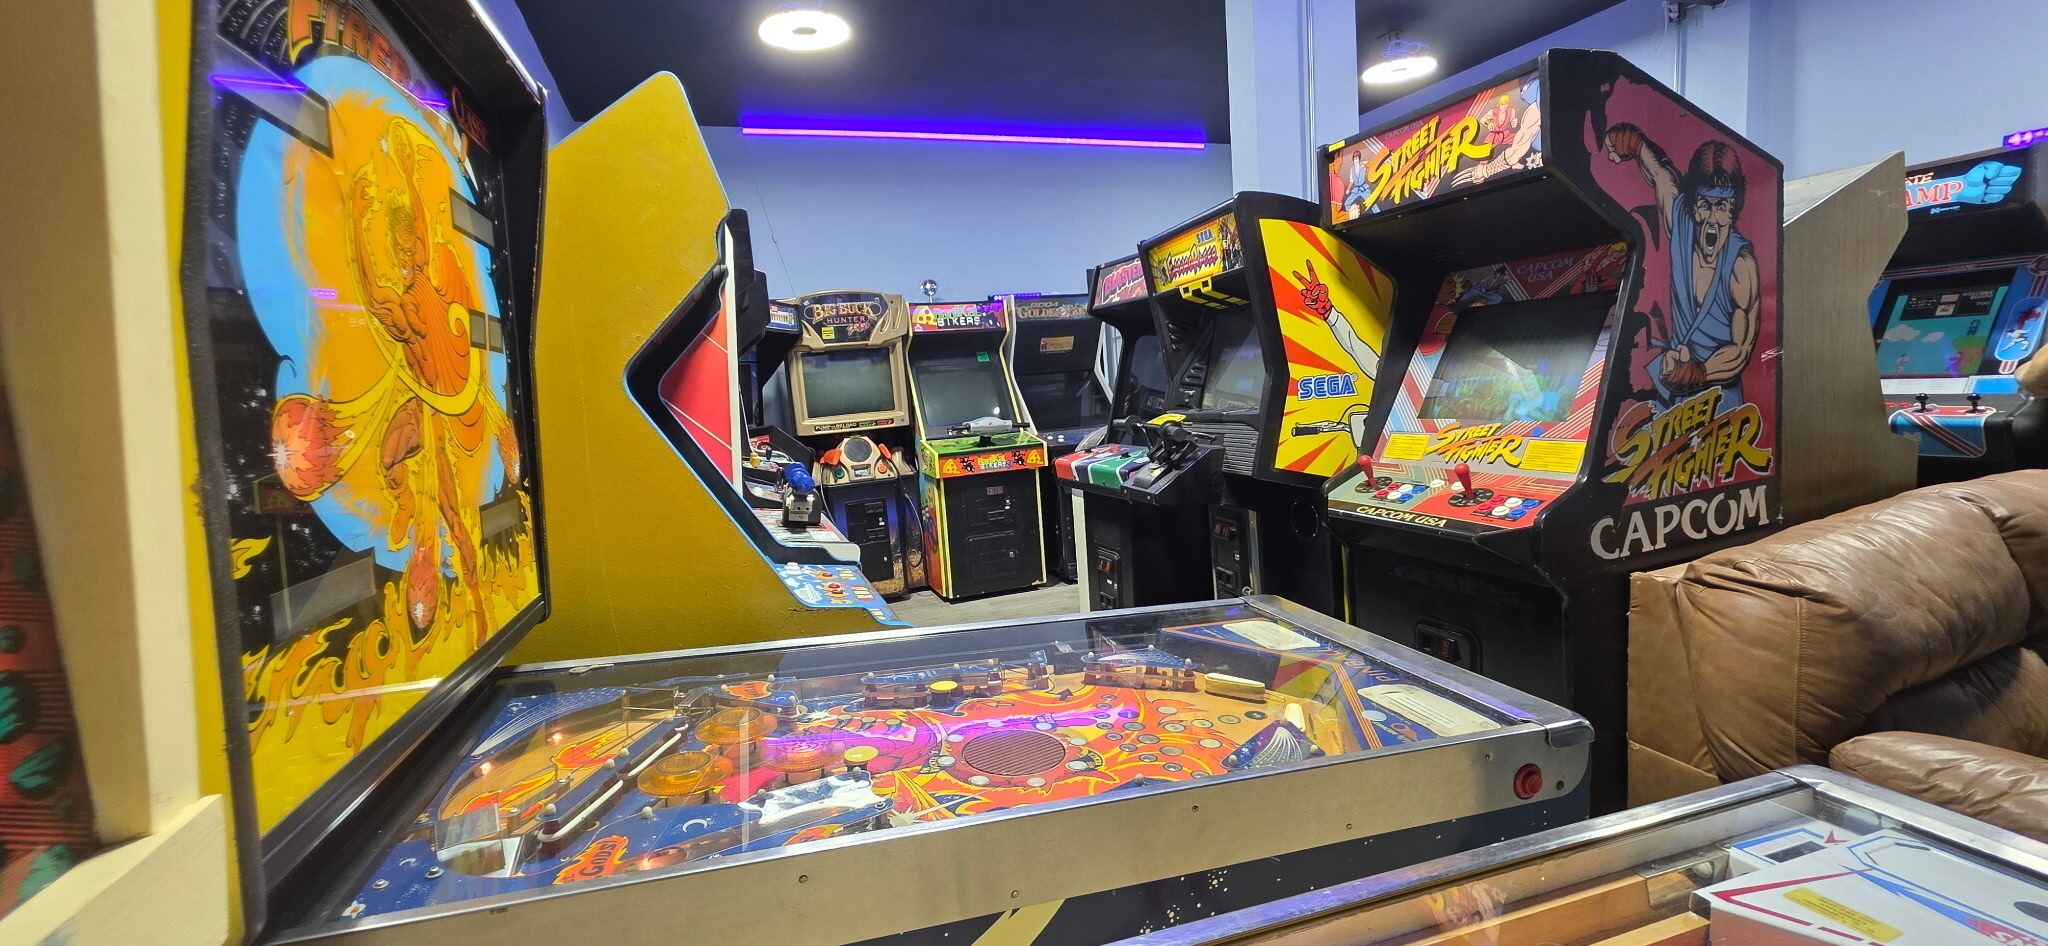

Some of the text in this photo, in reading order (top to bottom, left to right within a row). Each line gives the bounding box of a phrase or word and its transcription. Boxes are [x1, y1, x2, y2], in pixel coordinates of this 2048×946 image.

[1363, 114, 1440, 211] STREET
[1379, 114, 1493, 205] FIGHTER
[1905, 181, 1965, 207] AMP
[1196, 228, 1214, 244] SEGA
[1516, 257, 1574, 274] CAPCOM
[1528, 270, 1553, 282] USA
[826, 315, 866, 325] HUNTER
[937, 315, 980, 327] BIKERS
[1298, 374, 1358, 400] SEGA
[1424, 421, 1502, 456] STREET
[1601, 385, 1723, 484] STREET
[1436, 434, 1524, 468] FIGHTER
[1629, 403, 1773, 500] FIGHTER
[1356, 506, 1448, 528] CAPCOM USA
[1590, 484, 1770, 560] CAPCOM
